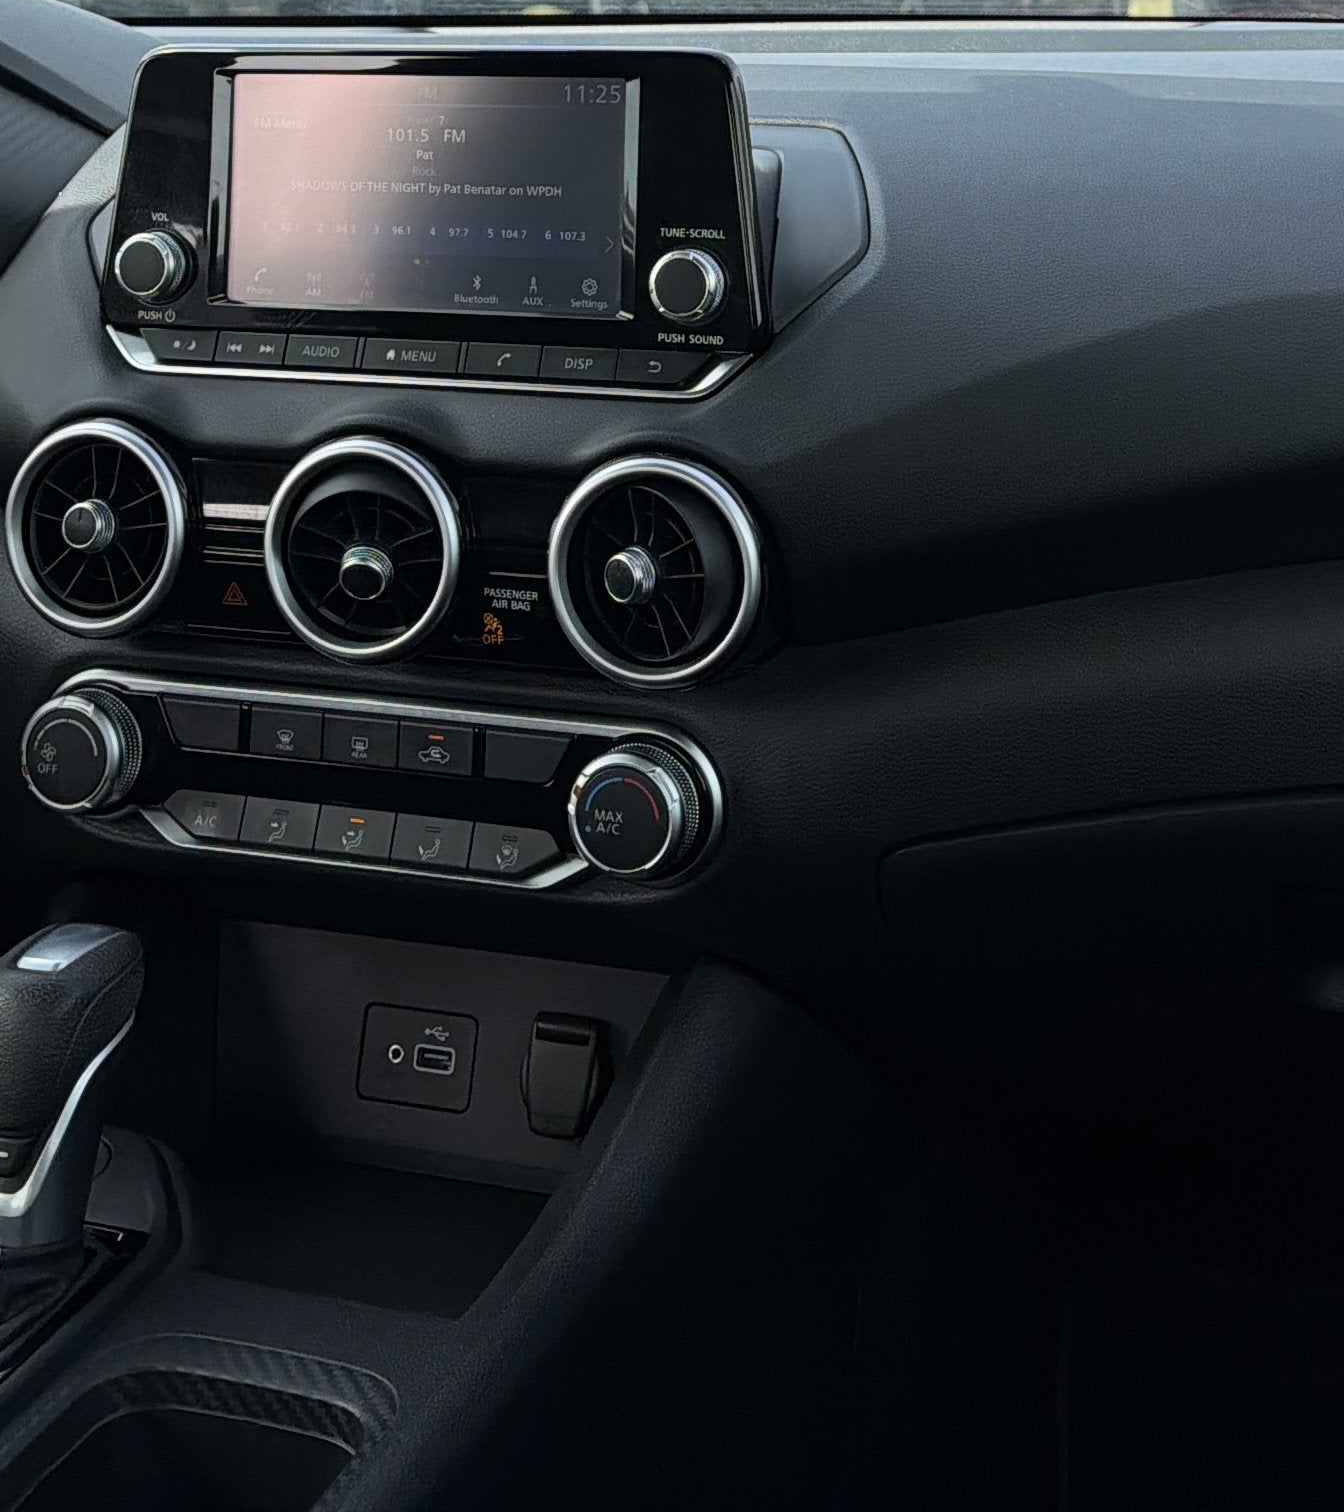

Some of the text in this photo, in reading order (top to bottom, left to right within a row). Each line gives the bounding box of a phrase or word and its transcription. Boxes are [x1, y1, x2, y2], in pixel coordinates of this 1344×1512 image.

[563, 83, 622, 104] 11:25
[439, 115, 445, 125] 7
[386, 128, 466, 143] 101.5 FM
[416, 149, 434, 161] Pat
[290, 179, 562, 197] SHADOWS OF THE NIGHT by Pat Benatar on WPDH
[151, 211, 170, 223] VOL
[373, 224, 380, 235] 3
[392, 224, 411, 235] 96.1
[429, 226, 436, 236] 4
[448, 227, 469, 238] 97.7
[487, 228, 494, 238] 5
[501, 229, 527, 239] 104.7
[544, 230, 552, 240] 6
[559, 231, 586, 241] 107.3
[305, 286, 321, 297] AM
[454, 293, 499, 305] Bluetooth
[522, 296, 544, 306] AUX
[570, 298, 608, 311] Settings
[138, 310, 163, 322] PUSH
[657, 333, 724, 346] PUSH SOUND
[302, 345, 340, 360] AUDIO
[400, 348, 437, 364] MENU
[564, 357, 594, 372] DISP
[483, 587, 539, 601] PASSENGER
[491, 599, 531, 612] AIR BAG
[482, 633, 505, 645] OFF
[275, 743, 295, 752] FRONT
[194, 813, 218, 827] A/C
[594, 808, 624, 823] MAX
[595, 821, 621, 836] A/C
